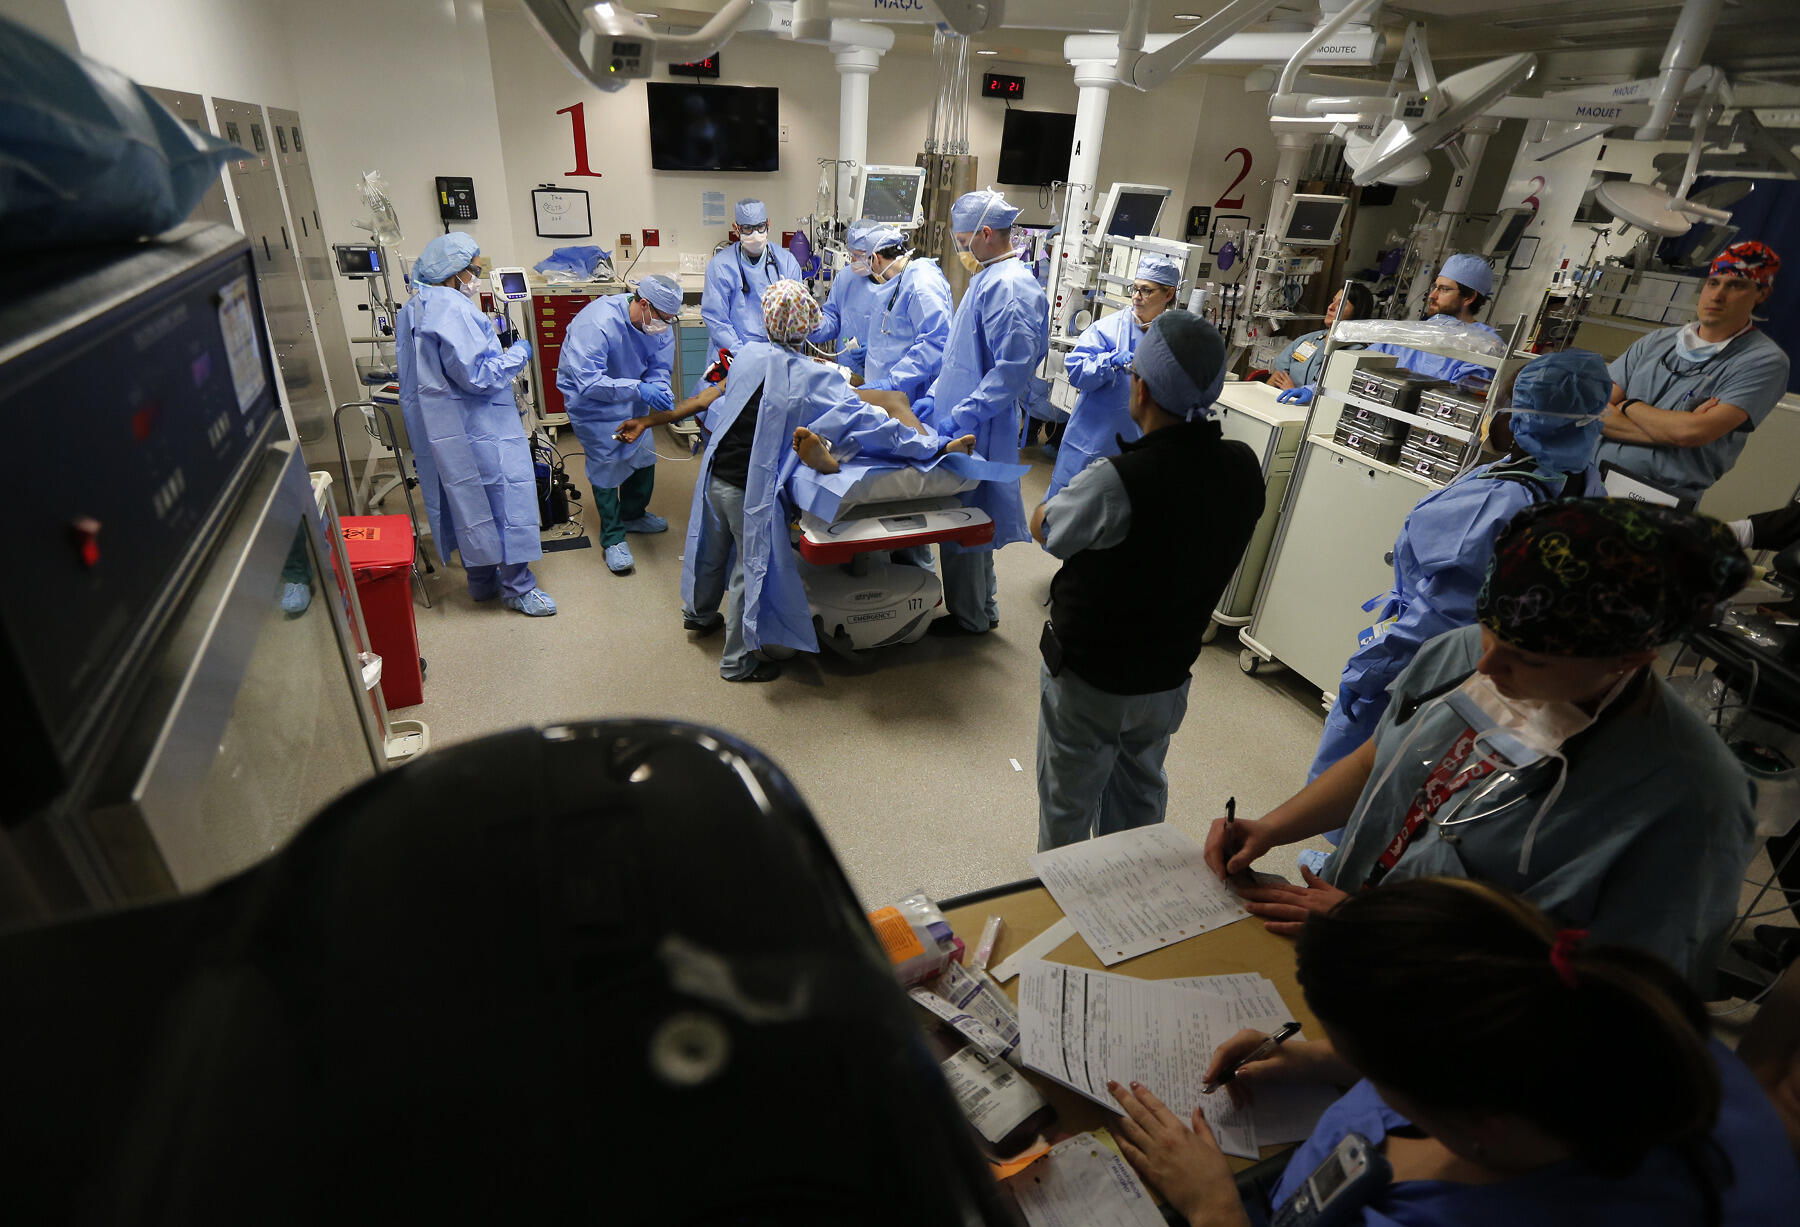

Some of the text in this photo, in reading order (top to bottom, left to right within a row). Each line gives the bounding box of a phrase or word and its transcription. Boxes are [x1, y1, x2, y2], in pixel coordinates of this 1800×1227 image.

[1317, 46, 1357, 54] MODUTEC
[1576, 106, 1623, 119] MAQUET
[556, 101, 603, 178] 1
[1074, 139, 1081, 156] A
[1214, 147, 1253, 210] 2
[1521, 175, 1546, 228] 3
[908, 598, 923, 611] 177
[853, 612, 891, 622] EMERGENCY
